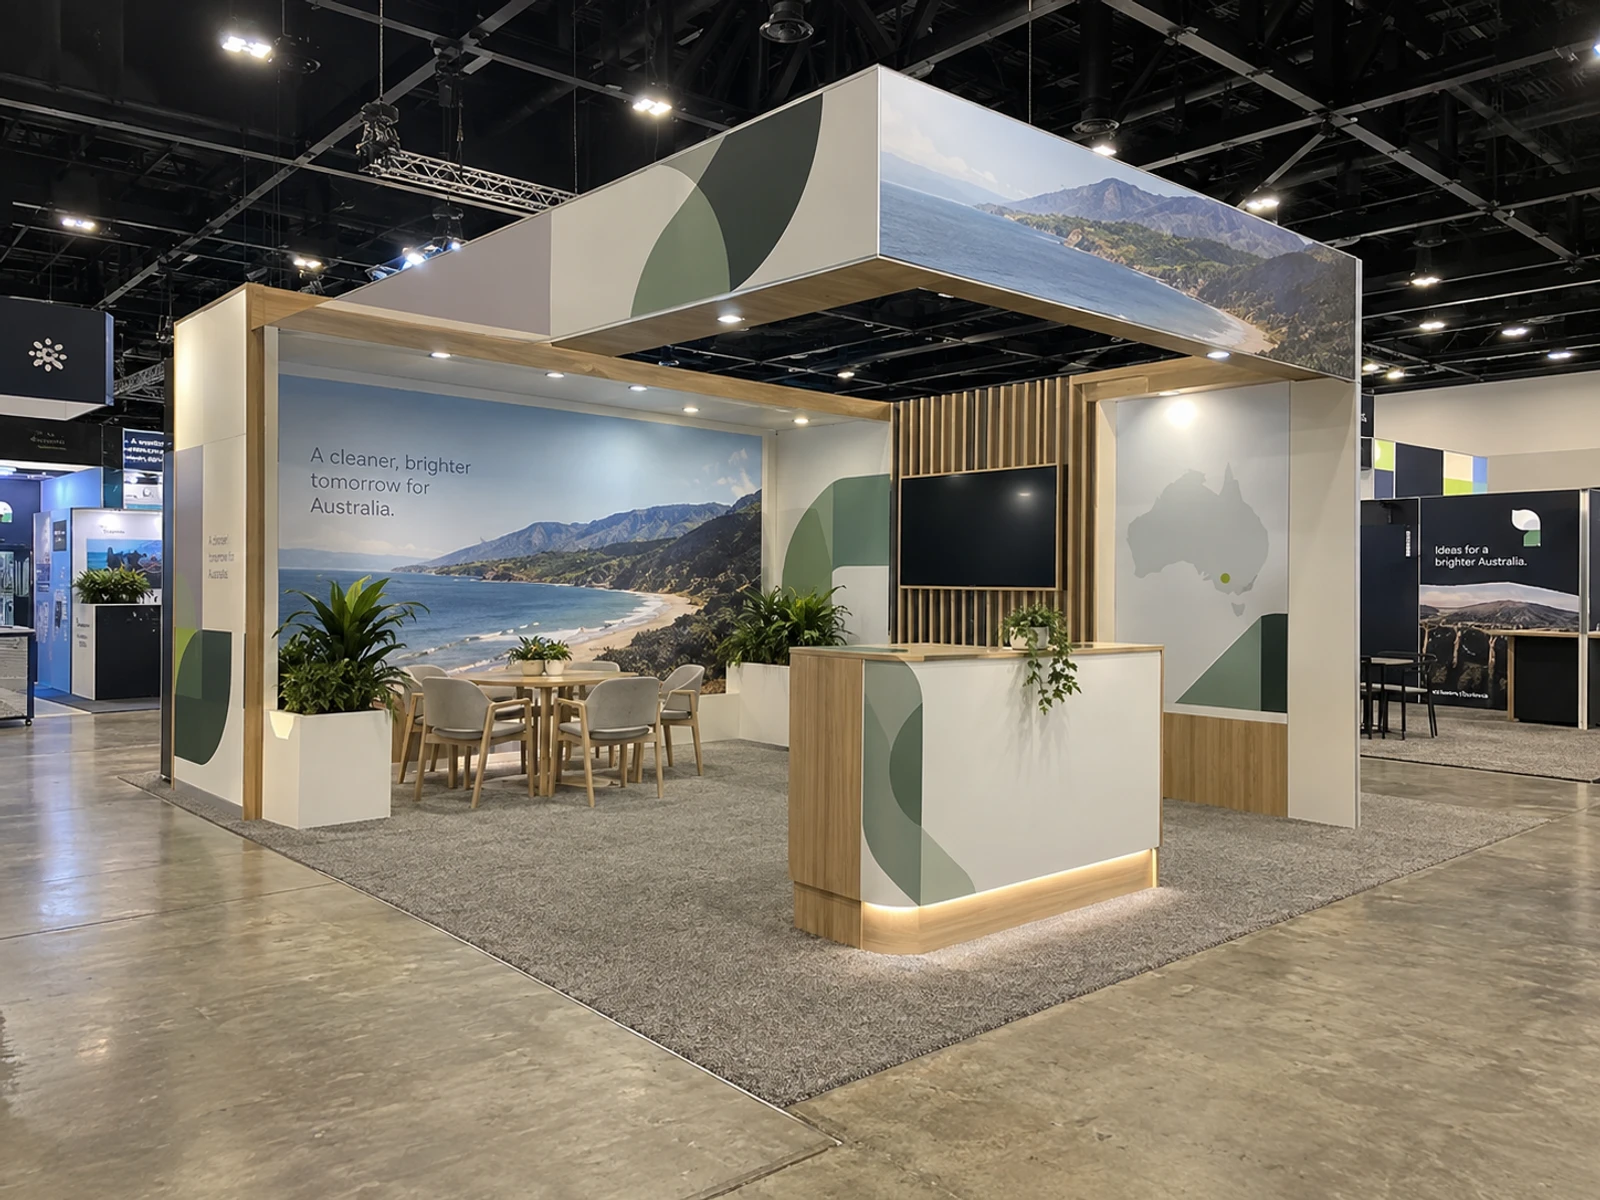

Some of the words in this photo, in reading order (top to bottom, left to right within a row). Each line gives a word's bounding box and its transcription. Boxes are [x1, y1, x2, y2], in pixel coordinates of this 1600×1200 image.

[310, 447, 324, 463] A
[330, 449, 399, 471] cleaner,
[405, 454, 472, 476] brighter
[311, 473, 401, 493] tomorrow
[407, 478, 430, 495] for
[310, 497, 395, 517] Australia.
[1435, 546, 1462, 555] Ideas
[1465, 544, 1480, 554] for
[1482, 546, 1489, 554] a
[1435, 556, 1476, 569] brighter
[1478, 556, 1528, 567] Australia.
